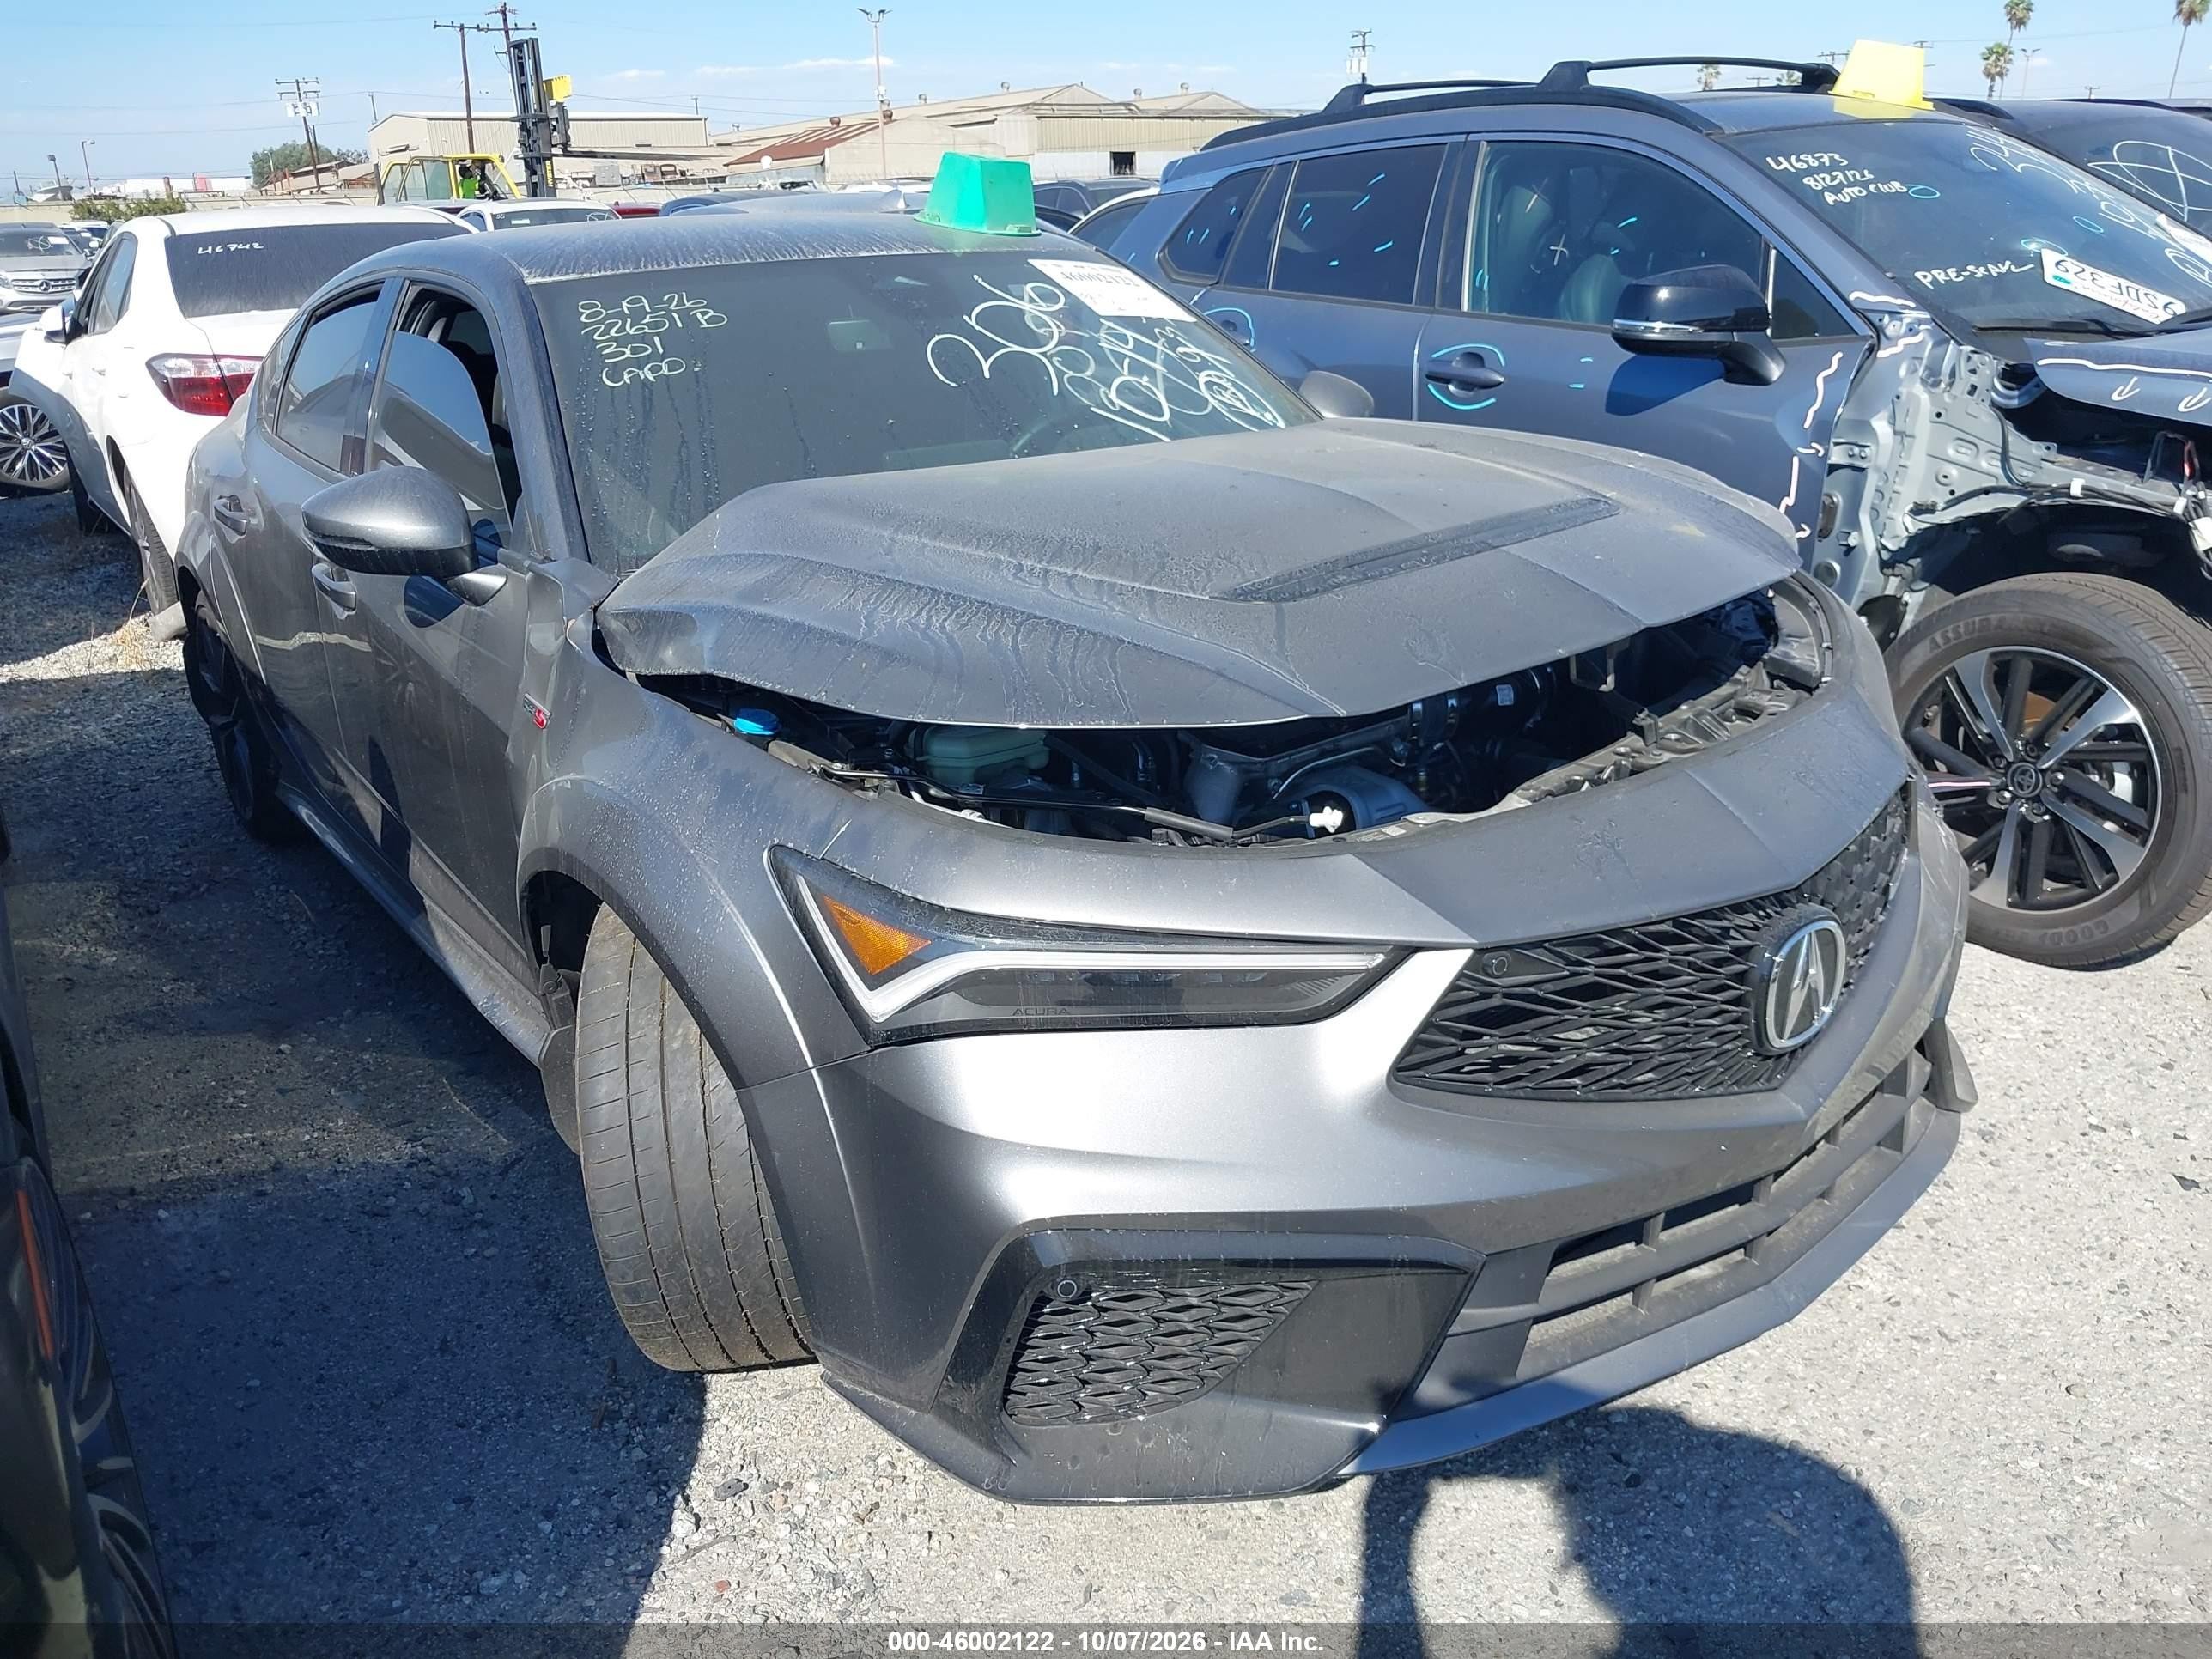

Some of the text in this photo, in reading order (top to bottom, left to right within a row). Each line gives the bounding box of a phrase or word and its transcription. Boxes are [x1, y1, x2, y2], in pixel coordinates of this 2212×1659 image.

[1765, 153, 1848, 172] 46873
[1823, 186, 1868, 206] AUTO
[578, 292, 707, 323] 8-19-26
[595, 336, 664, 362] 301
[1012, 1007, 1069, 1016] ACURA
